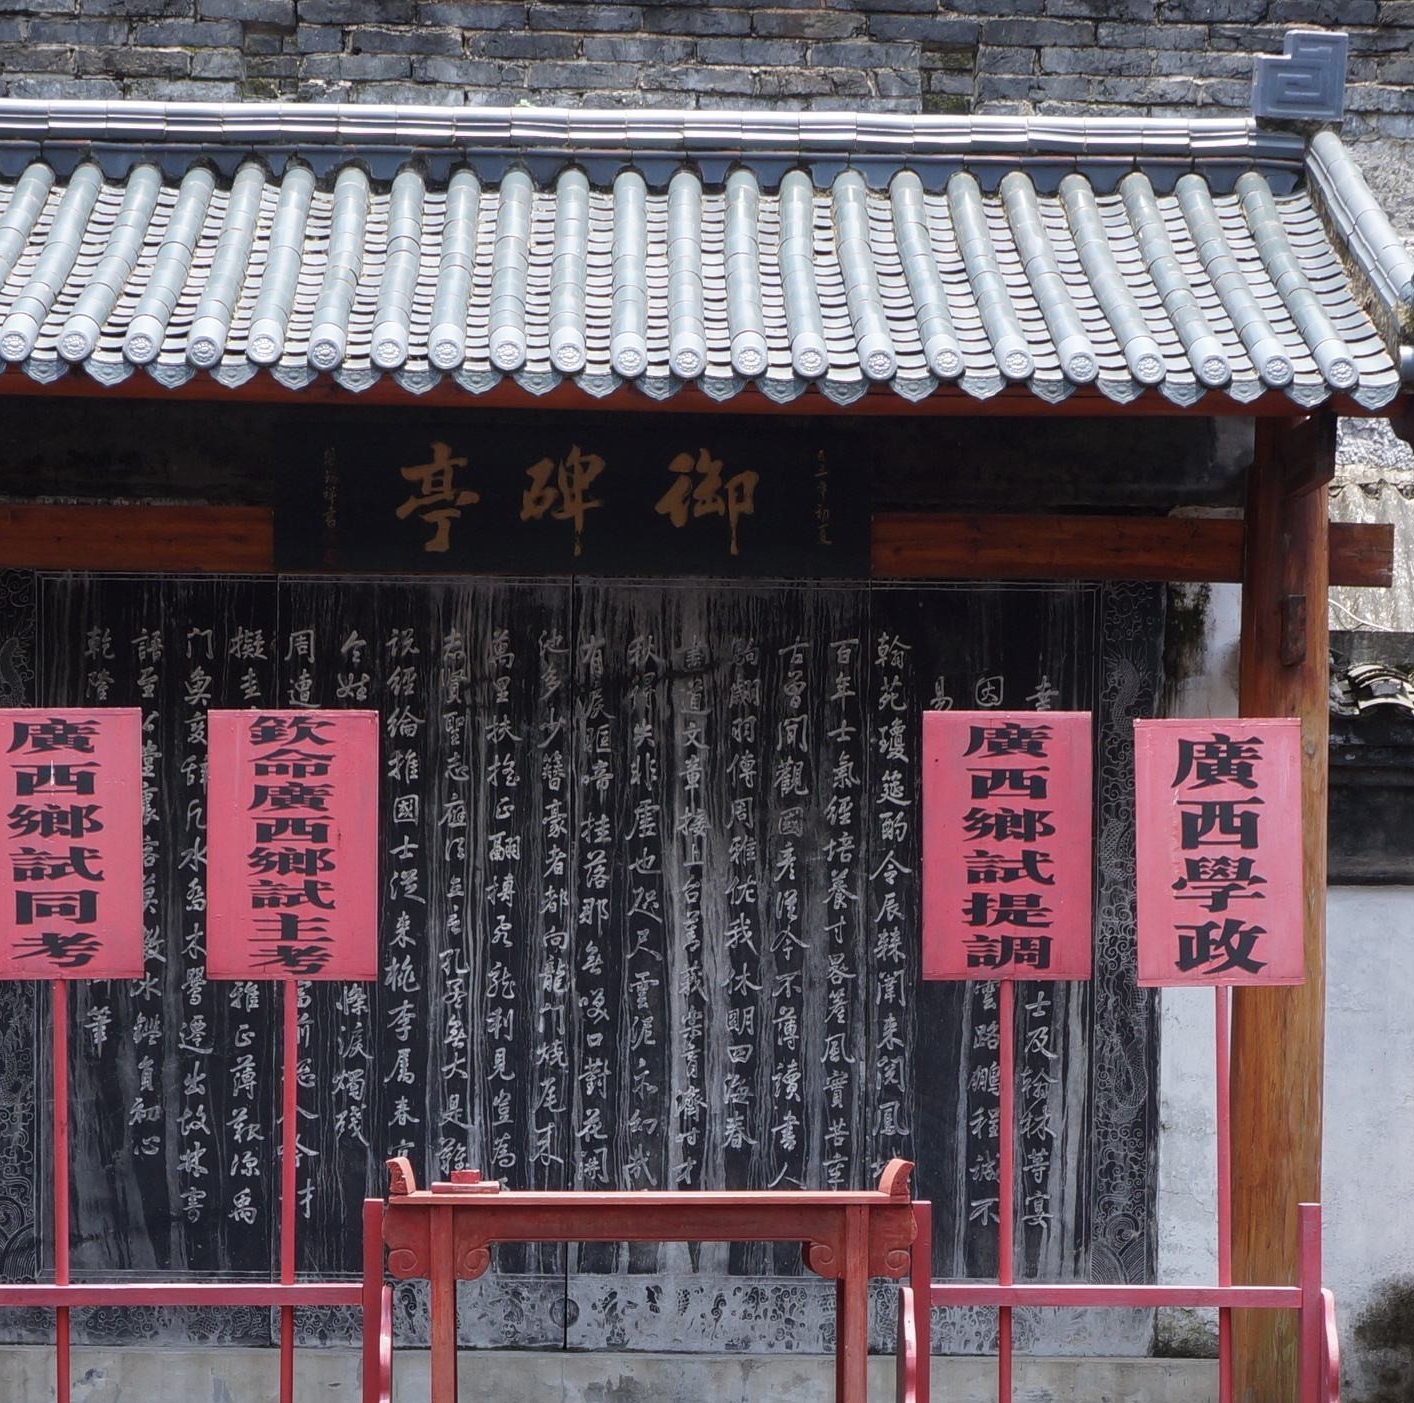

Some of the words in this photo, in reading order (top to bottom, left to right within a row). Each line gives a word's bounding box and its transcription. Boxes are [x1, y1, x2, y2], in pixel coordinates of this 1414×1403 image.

[396, 440, 760, 556] 御碑亭
[975, 675, 1004, 707] 因
[7, 717, 104, 968] 廣西鄉試同考
[248, 714, 336, 975] 欽命廣西鄉試主考
[962, 722, 1056, 970] 廣西鄉試提調
[1171, 732, 1268, 976] 廣西學政
